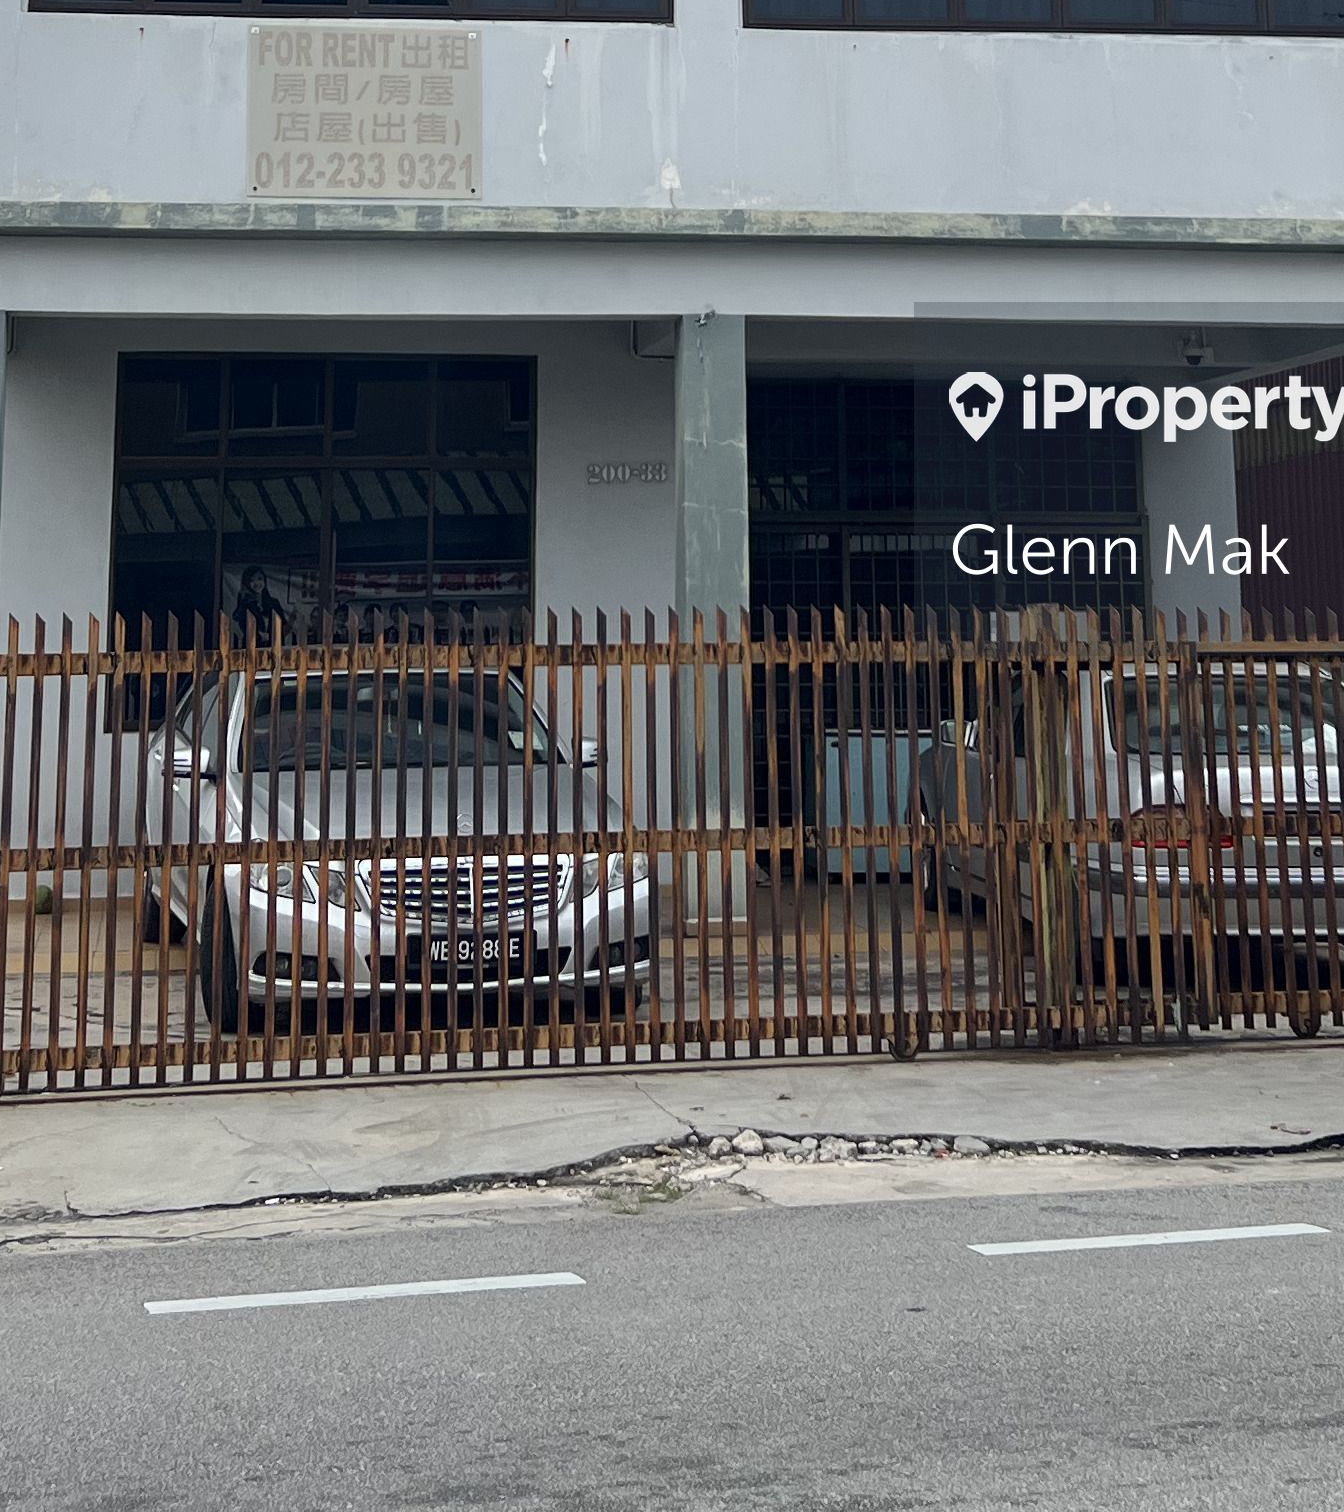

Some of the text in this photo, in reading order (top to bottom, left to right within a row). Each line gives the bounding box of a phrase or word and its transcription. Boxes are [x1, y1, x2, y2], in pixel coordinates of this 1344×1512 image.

[258, 31, 469, 70] FOR RENT 出租
[256, 152, 473, 190] 012-233 9321
[587, 462, 667, 484] 200-33
